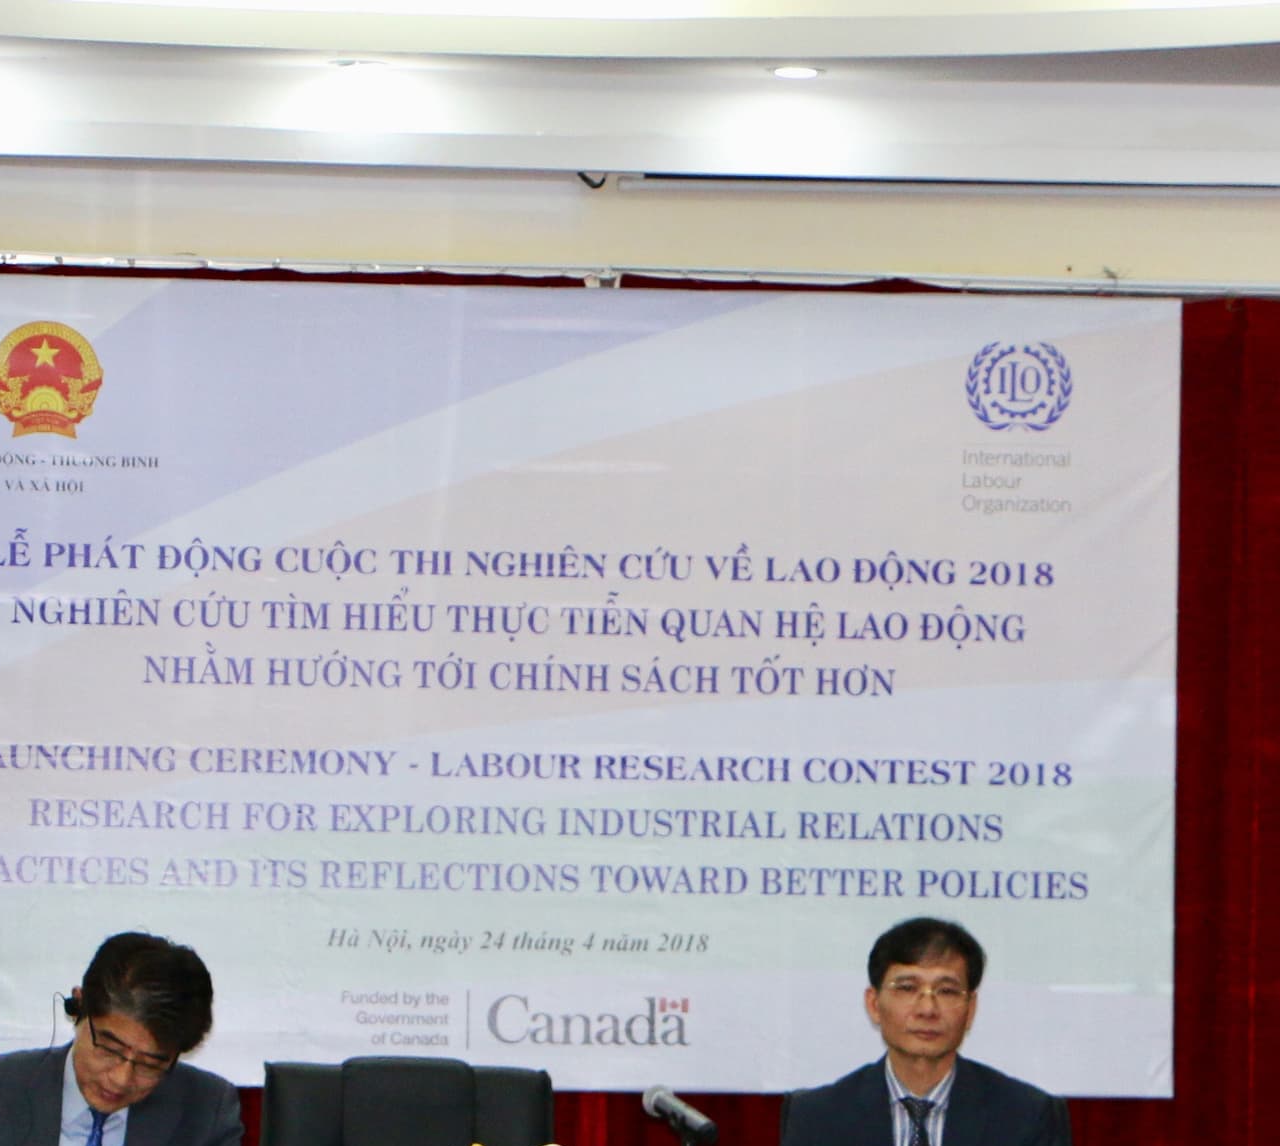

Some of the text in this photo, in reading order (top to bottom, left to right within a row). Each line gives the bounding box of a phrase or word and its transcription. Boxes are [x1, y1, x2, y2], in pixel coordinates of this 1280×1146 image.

[998, 361, 1042, 402] ILO
[962, 449, 1071, 467] International
[962, 472, 1022, 488] Labour
[961, 494, 1072, 515] Organization
[43, 535, 145, 569] PHÁT
[158, 537, 263, 579] ĐỘNG
[275, 540, 377, 580] CUỘC
[390, 549, 453, 576] THI
[465, 544, 607, 579] NGHIÊN
[618, 546, 693, 580] CỨU
[705, 543, 753, 582] VỀ
[765, 557, 841, 584] LAO
[852, 551, 956, 591] ĐỘNG
[968, 560, 1055, 587] 2018
[11, 586, 1026, 649] NGHIÊN CỨU TÌM HIỂU THỰC TIỄN QUAN HỆ LAO ĐỘNG
[143, 641, 896, 697] NHẰM HƯỚNG TỚI CHÍNH SÁCH TỐT HƠN
[189, 746, 398, 777] CEREMONY
[431, 751, 581, 780] LABOUR
[593, 754, 791, 783] RESEARCH
[803, 758, 976, 787] CONTEST
[988, 760, 1073, 788] 2018
[28, 798, 1004, 843] RESEARCH FOR EXPLORING INDUSTRIAL RELATIONS
[160, 858, 239, 888] AND
[250, 860, 308, 888] ITS
[320, 861, 580, 894] REFLECTIONS
[591, 866, 749, 895] TOWARD
[759, 867, 903, 898] BETTER
[916, 871, 1089, 901] POLICIES
[326, 927, 710, 955] Hà Nội, ngày 24 tháng 4 năm 2018
[341, 991, 449, 1008] Funded by the
[355, 1010, 449, 1025] Government
[487, 994, 691, 1046] Canada
[371, 1031, 449, 1046] of Canada
